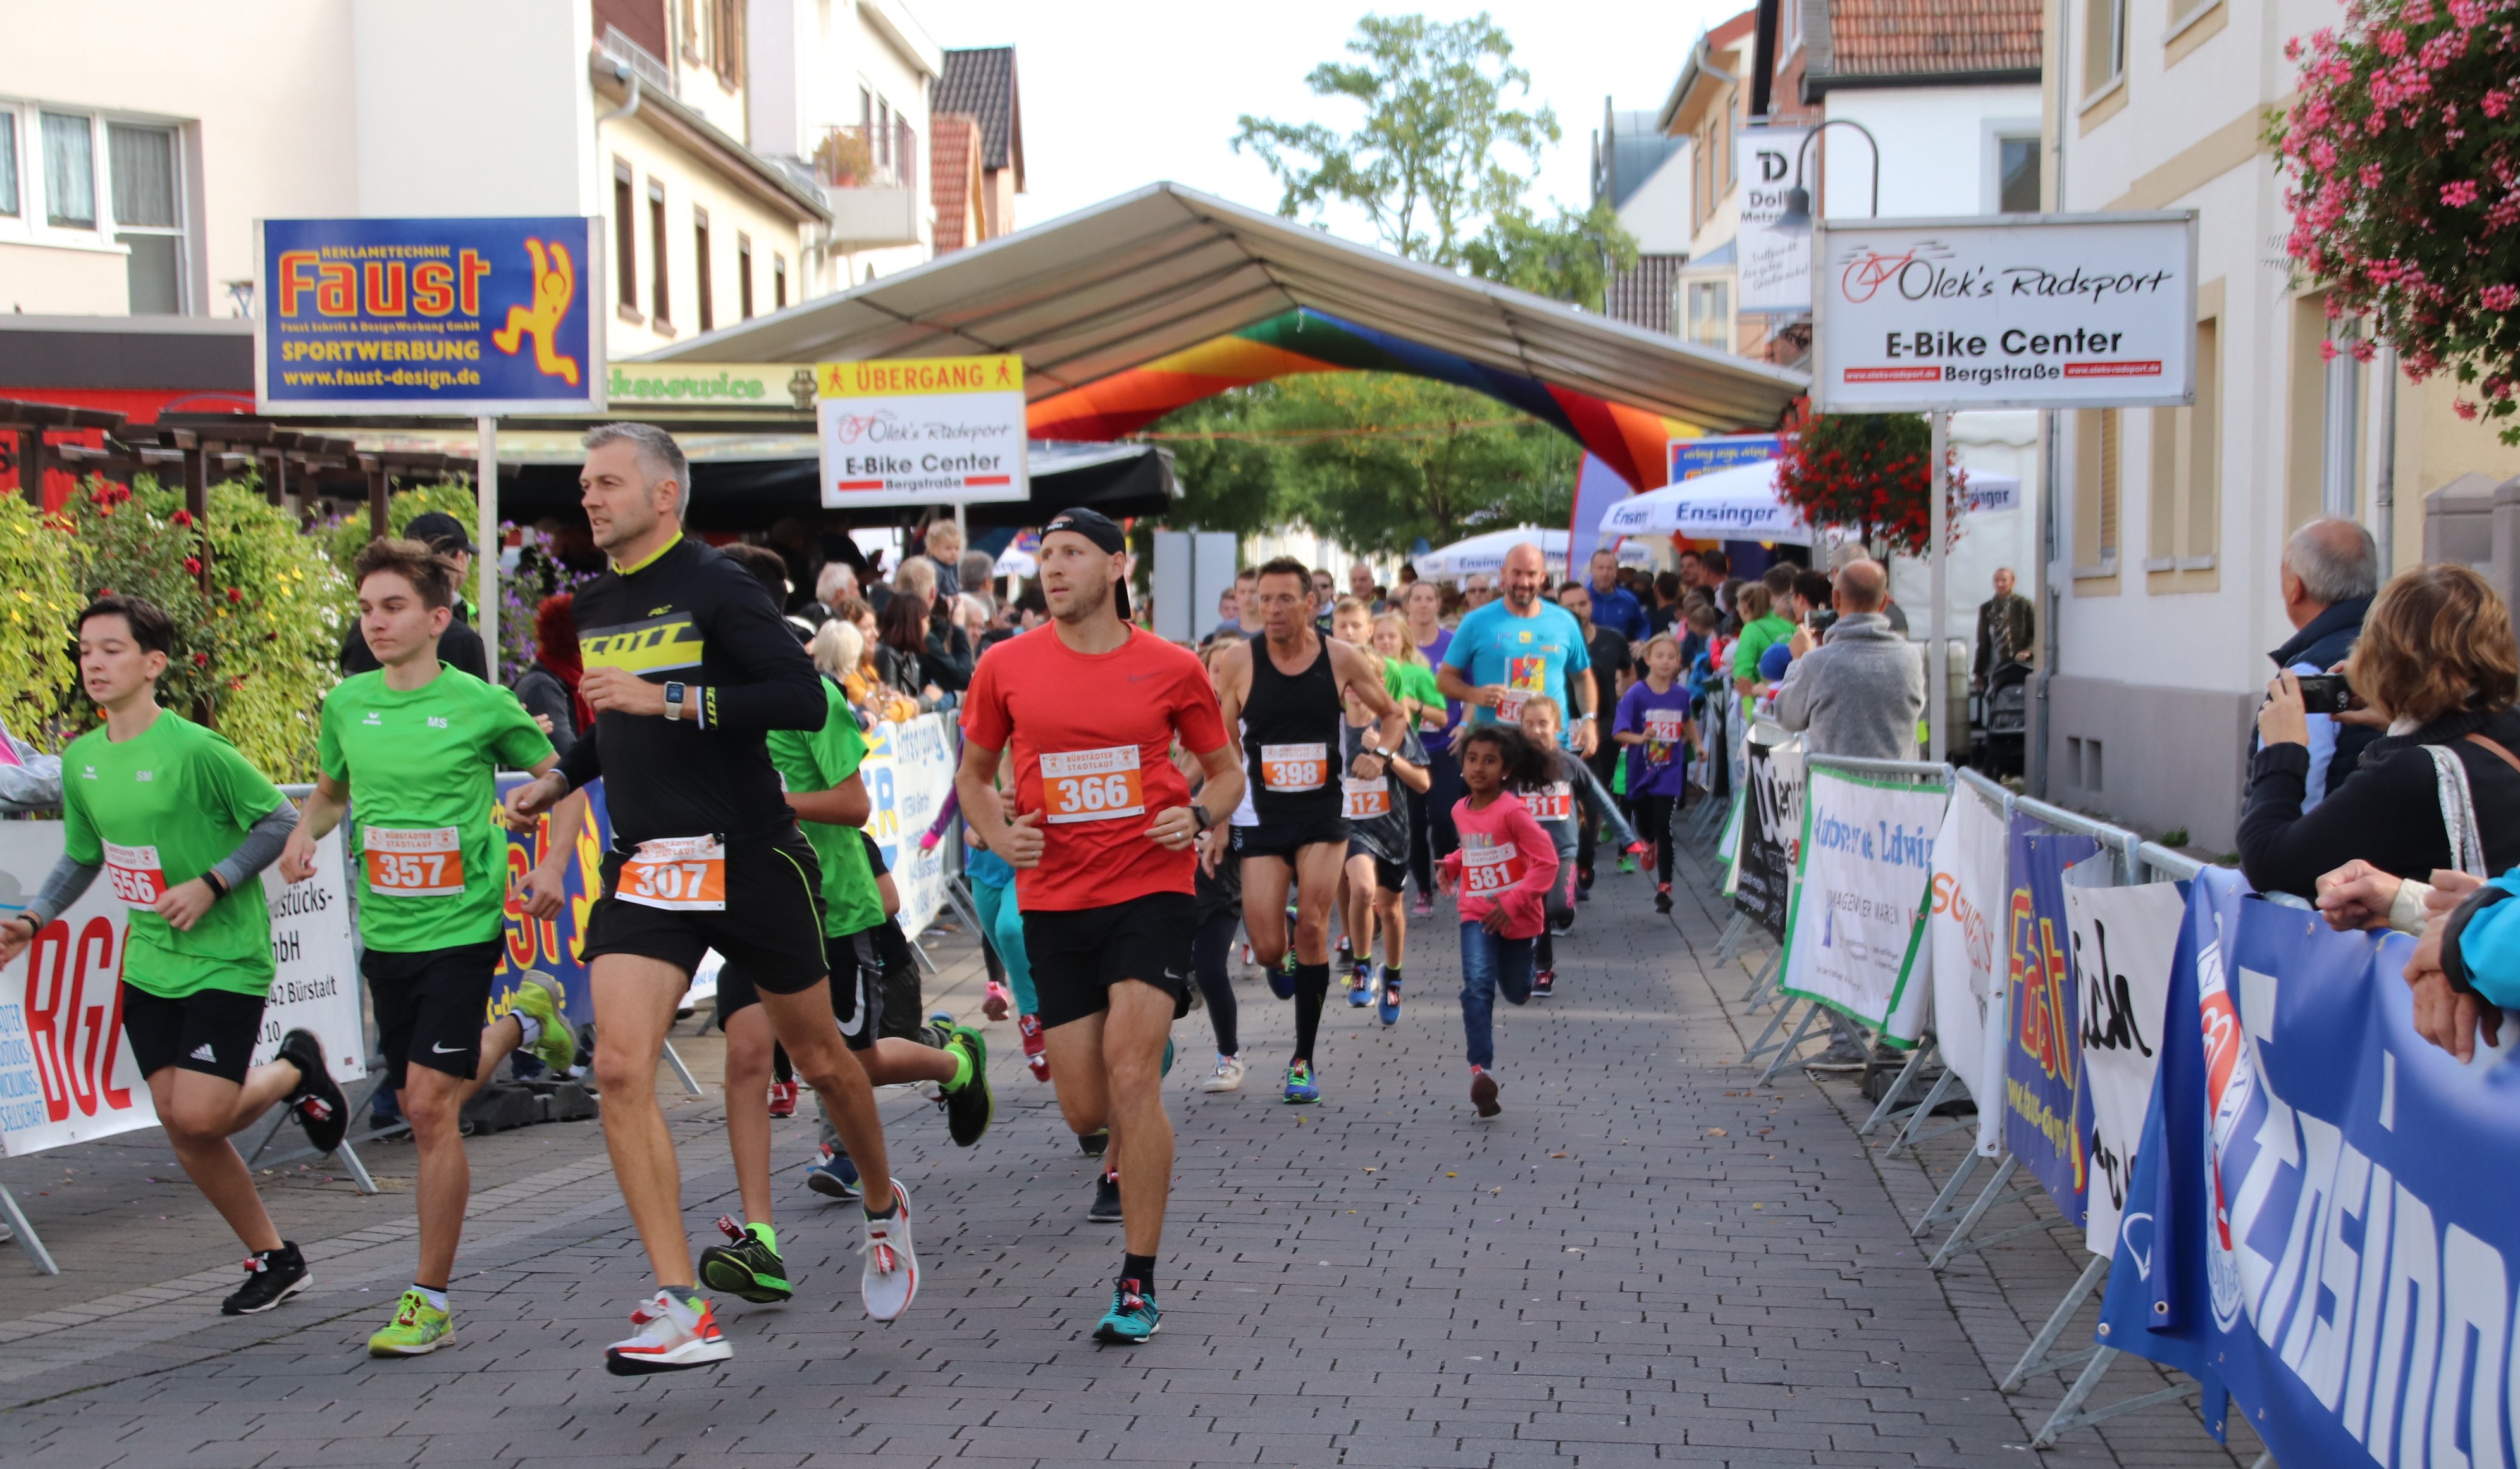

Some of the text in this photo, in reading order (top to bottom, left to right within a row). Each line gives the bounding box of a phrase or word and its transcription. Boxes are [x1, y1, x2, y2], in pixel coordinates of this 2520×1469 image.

[321, 245, 450, 259] REKLAMETECHNIK
[278, 248, 491, 317] Faust
[1898, 259, 2173, 304] Olek's Radsport
[280, 321, 310, 333] Faust
[312, 321, 348, 333] Schrift
[350, 322, 358, 332] &
[446, 321, 480, 332] GmbH
[282, 340, 480, 361] SPORTWERBUNG
[1886, 326, 2123, 359] E-Bike Center
[283, 367, 481, 390] www.faust-design.de
[606, 369, 766, 397] keservice
[855, 363, 985, 392] ÜBERGANG
[1944, 363, 2061, 387] Bergstraße
[922, 421, 1013, 442] Radsport
[846, 451, 1001, 475] E-Bike Center
[886, 477, 962, 493] Bergstraße
[1676, 501, 1778, 527] Ensinger
[427, 716, 448, 729] MS
[1066, 752, 1114, 763] BÜRSTÄDTER
[1066, 760, 1115, 771] STADTLAUF
[135, 770, 153, 782] SM
[1272, 761, 1318, 786] 398
[1058, 774, 1129, 813] 366
[1526, 797, 1561, 815] 511
[378, 853, 446, 888] 357
[634, 863, 708, 899] 307
[1468, 862, 1512, 890] 581
[108, 866, 157, 903] 556
[273, 881, 333, 919] stücks-
[287, 973, 337, 1003] Bürstadt
[266, 1020, 281, 1043] 10
